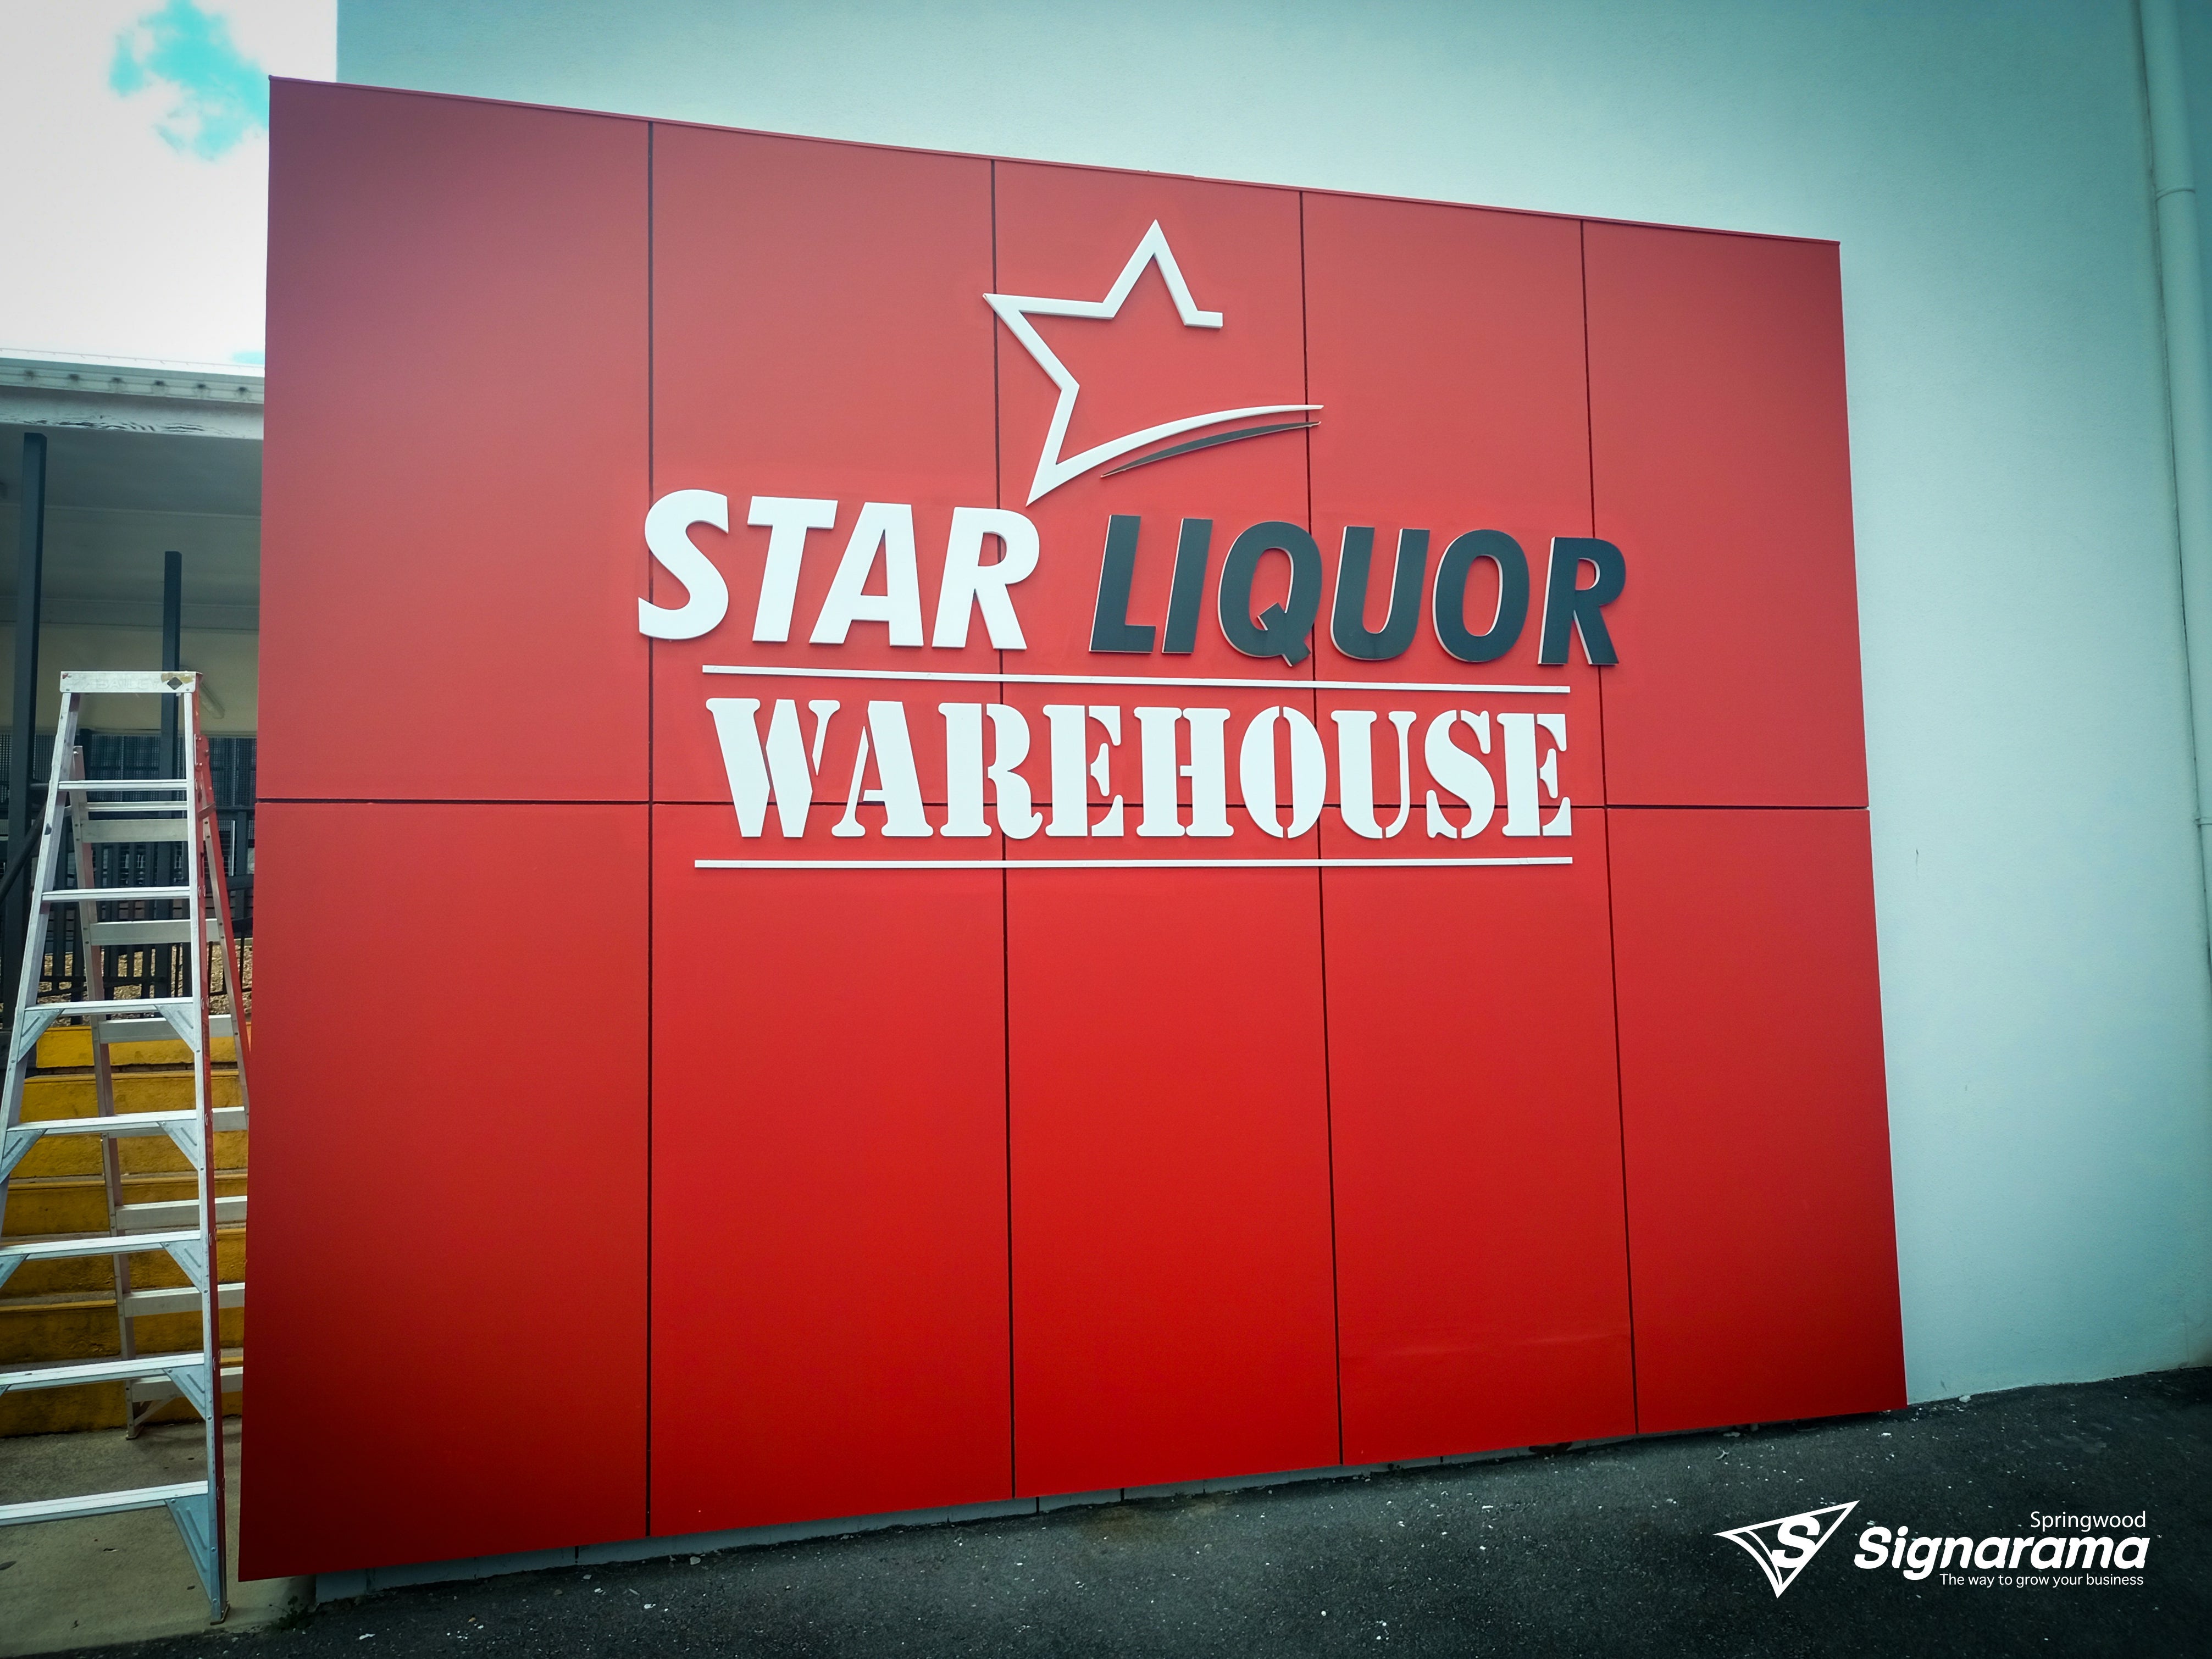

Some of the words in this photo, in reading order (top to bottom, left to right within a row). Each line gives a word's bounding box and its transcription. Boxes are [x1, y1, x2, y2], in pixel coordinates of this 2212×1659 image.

[638, 489, 1040, 650] STAR
[1089, 514, 1626, 667] LIQUOR
[706, 697, 1572, 839] WAREHOUSE
